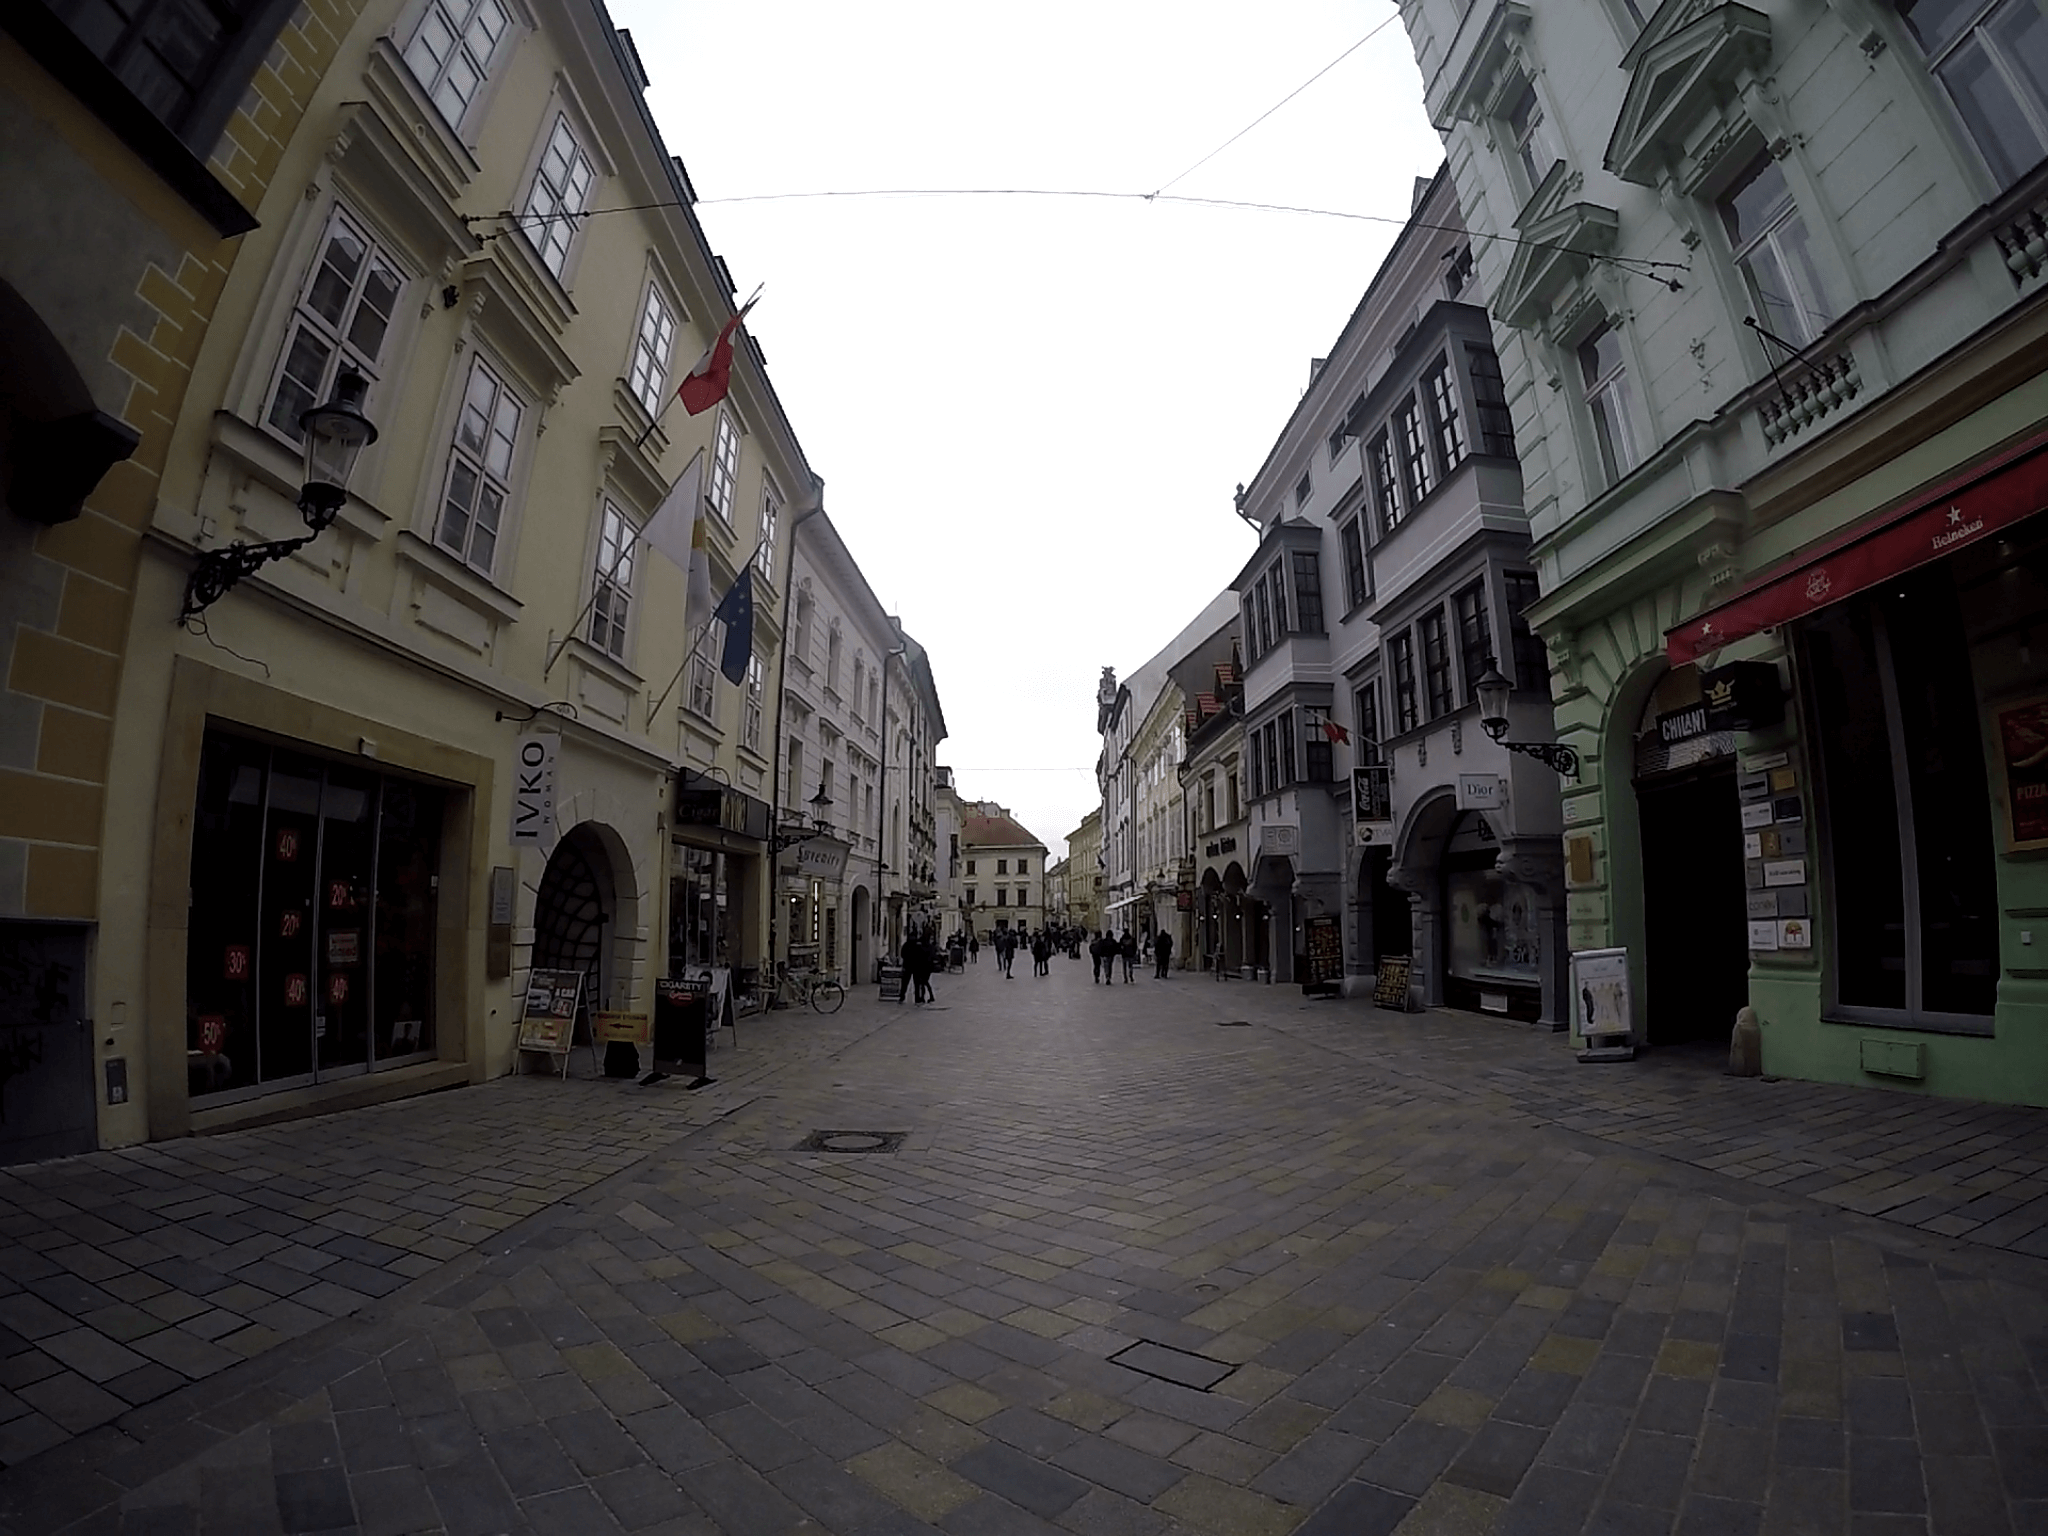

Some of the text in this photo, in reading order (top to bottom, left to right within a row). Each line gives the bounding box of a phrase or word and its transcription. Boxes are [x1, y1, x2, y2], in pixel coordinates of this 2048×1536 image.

[1931, 515, 1984, 549] Heineken
[515, 742, 544, 837] IVKO
[544, 756, 554, 824] WOMAN
[1467, 784, 1493, 795] Dior
